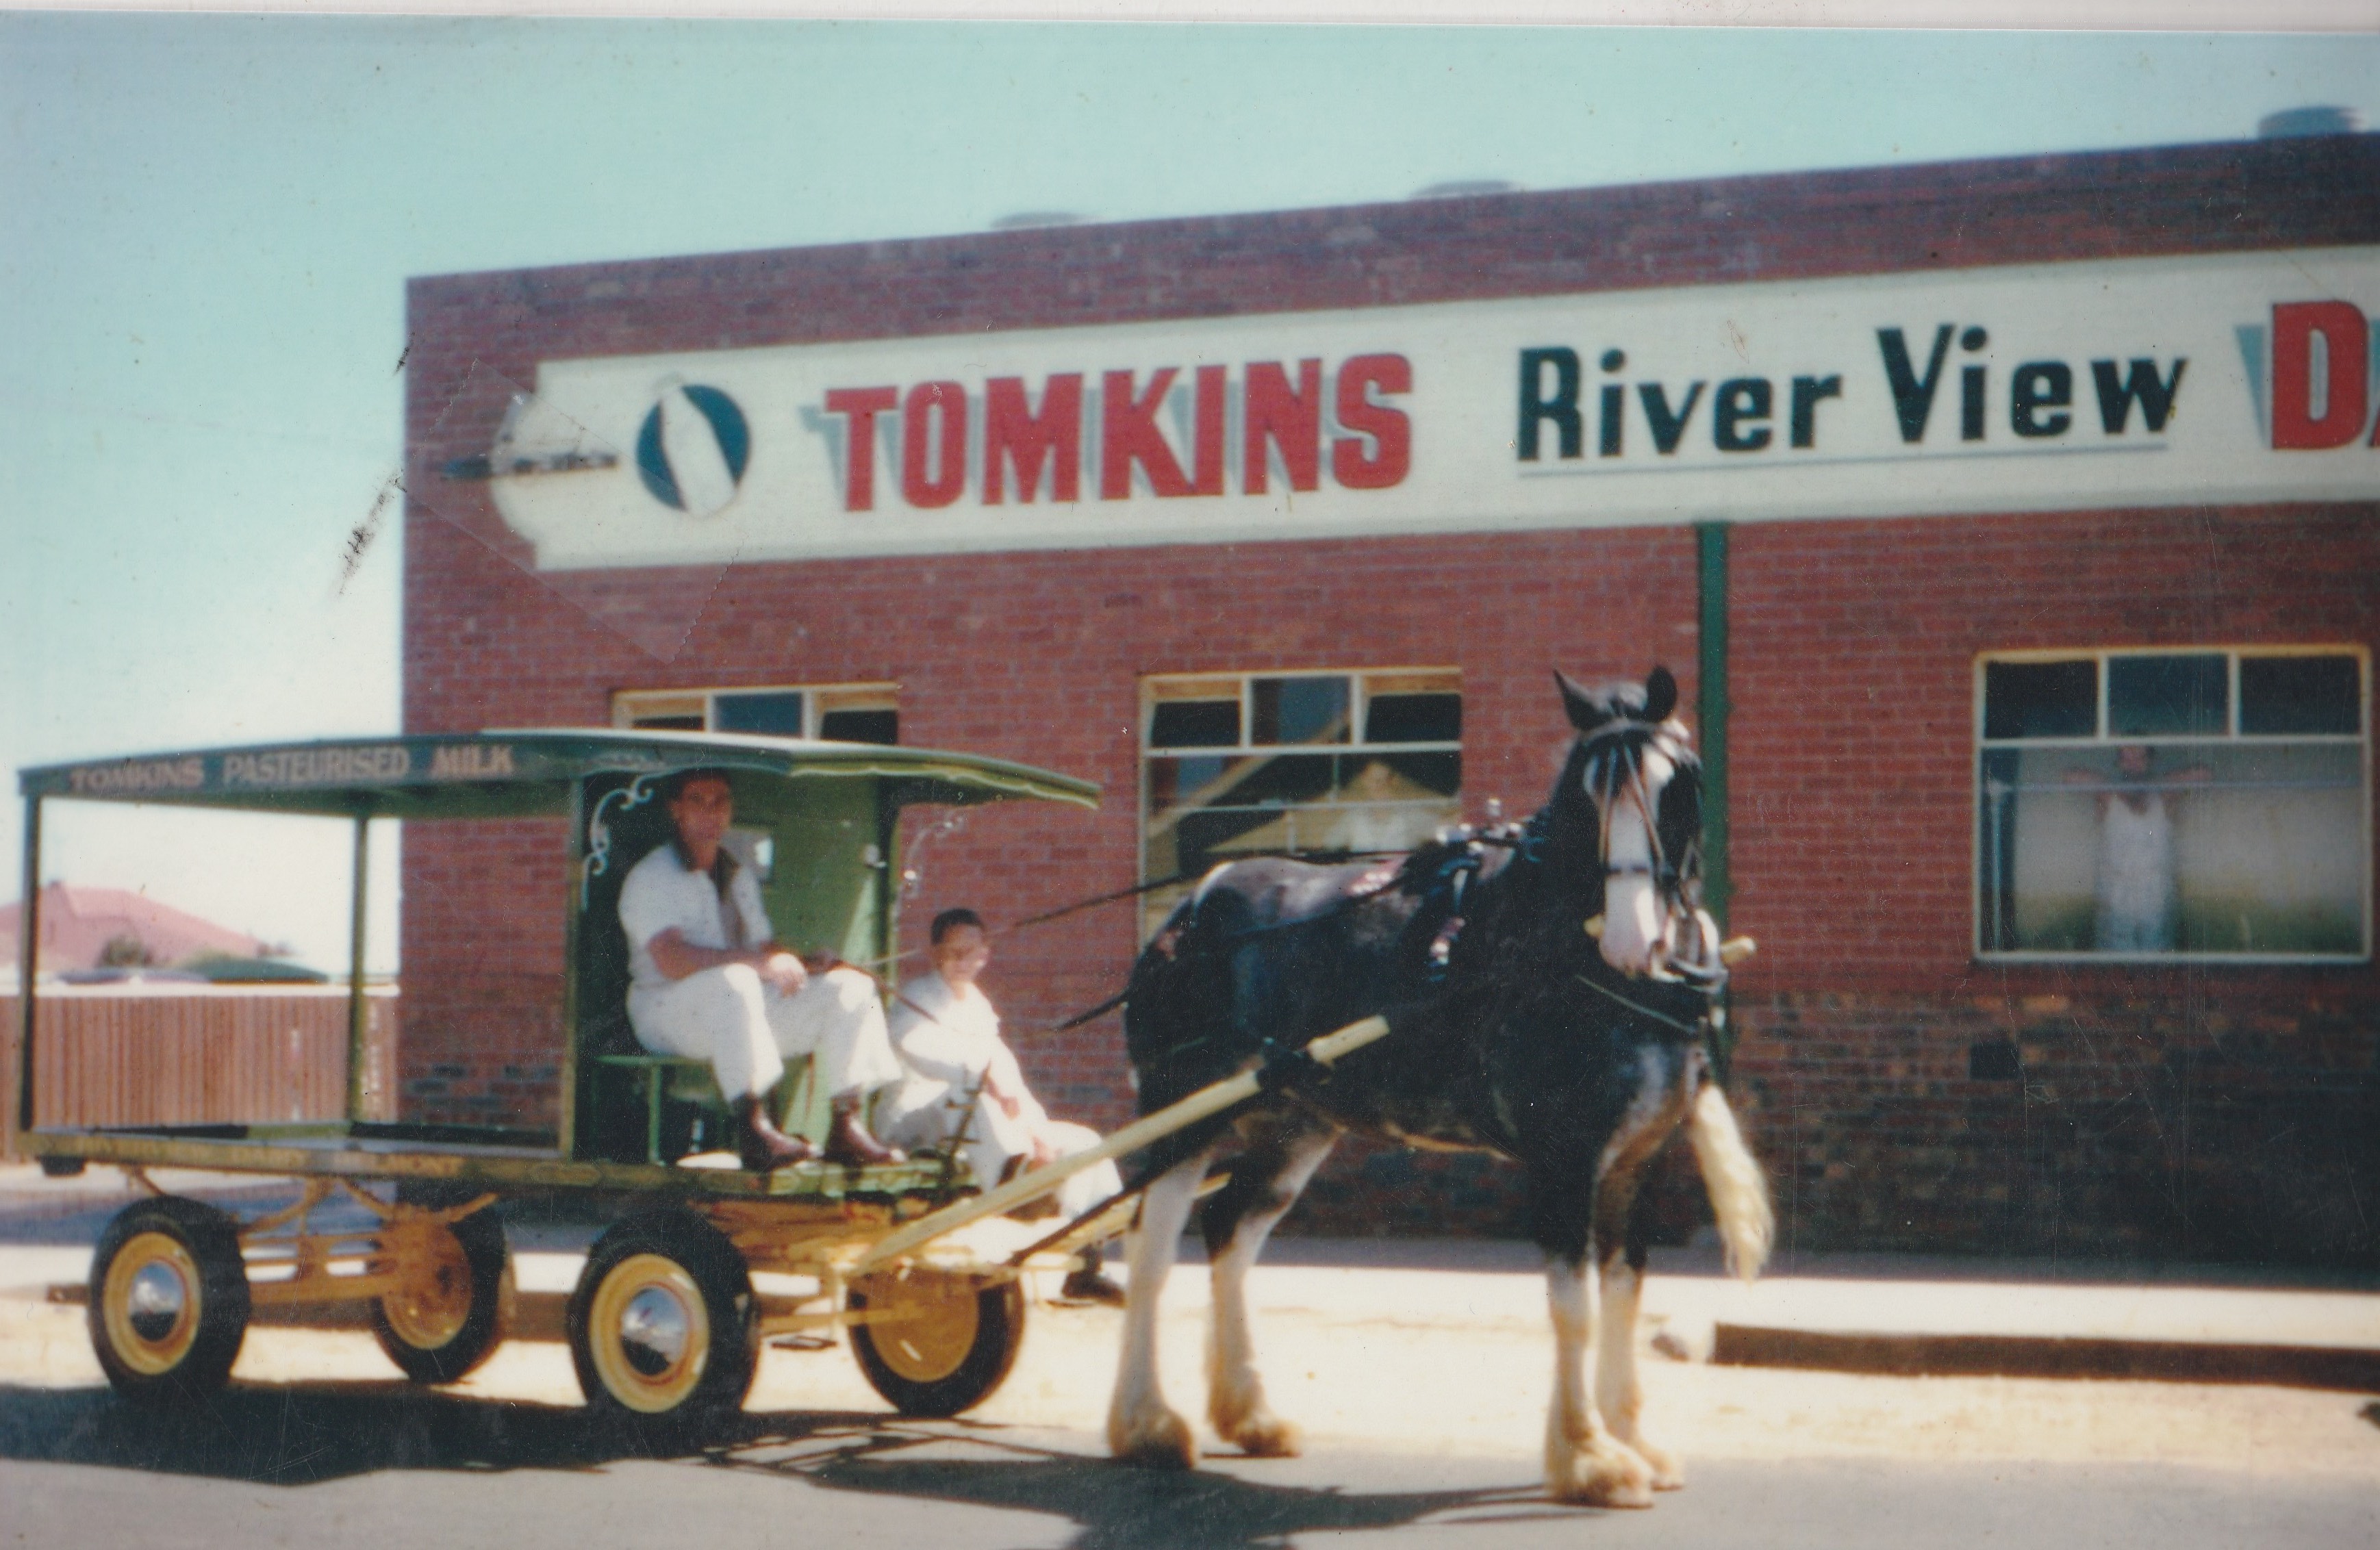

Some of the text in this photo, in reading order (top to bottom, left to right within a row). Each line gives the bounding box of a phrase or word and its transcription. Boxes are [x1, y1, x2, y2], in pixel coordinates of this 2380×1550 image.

[824, 301, 2380, 512] TOMKINS River View D
[71, 744, 515, 791] TOMKINS PASTEURISED MILK
